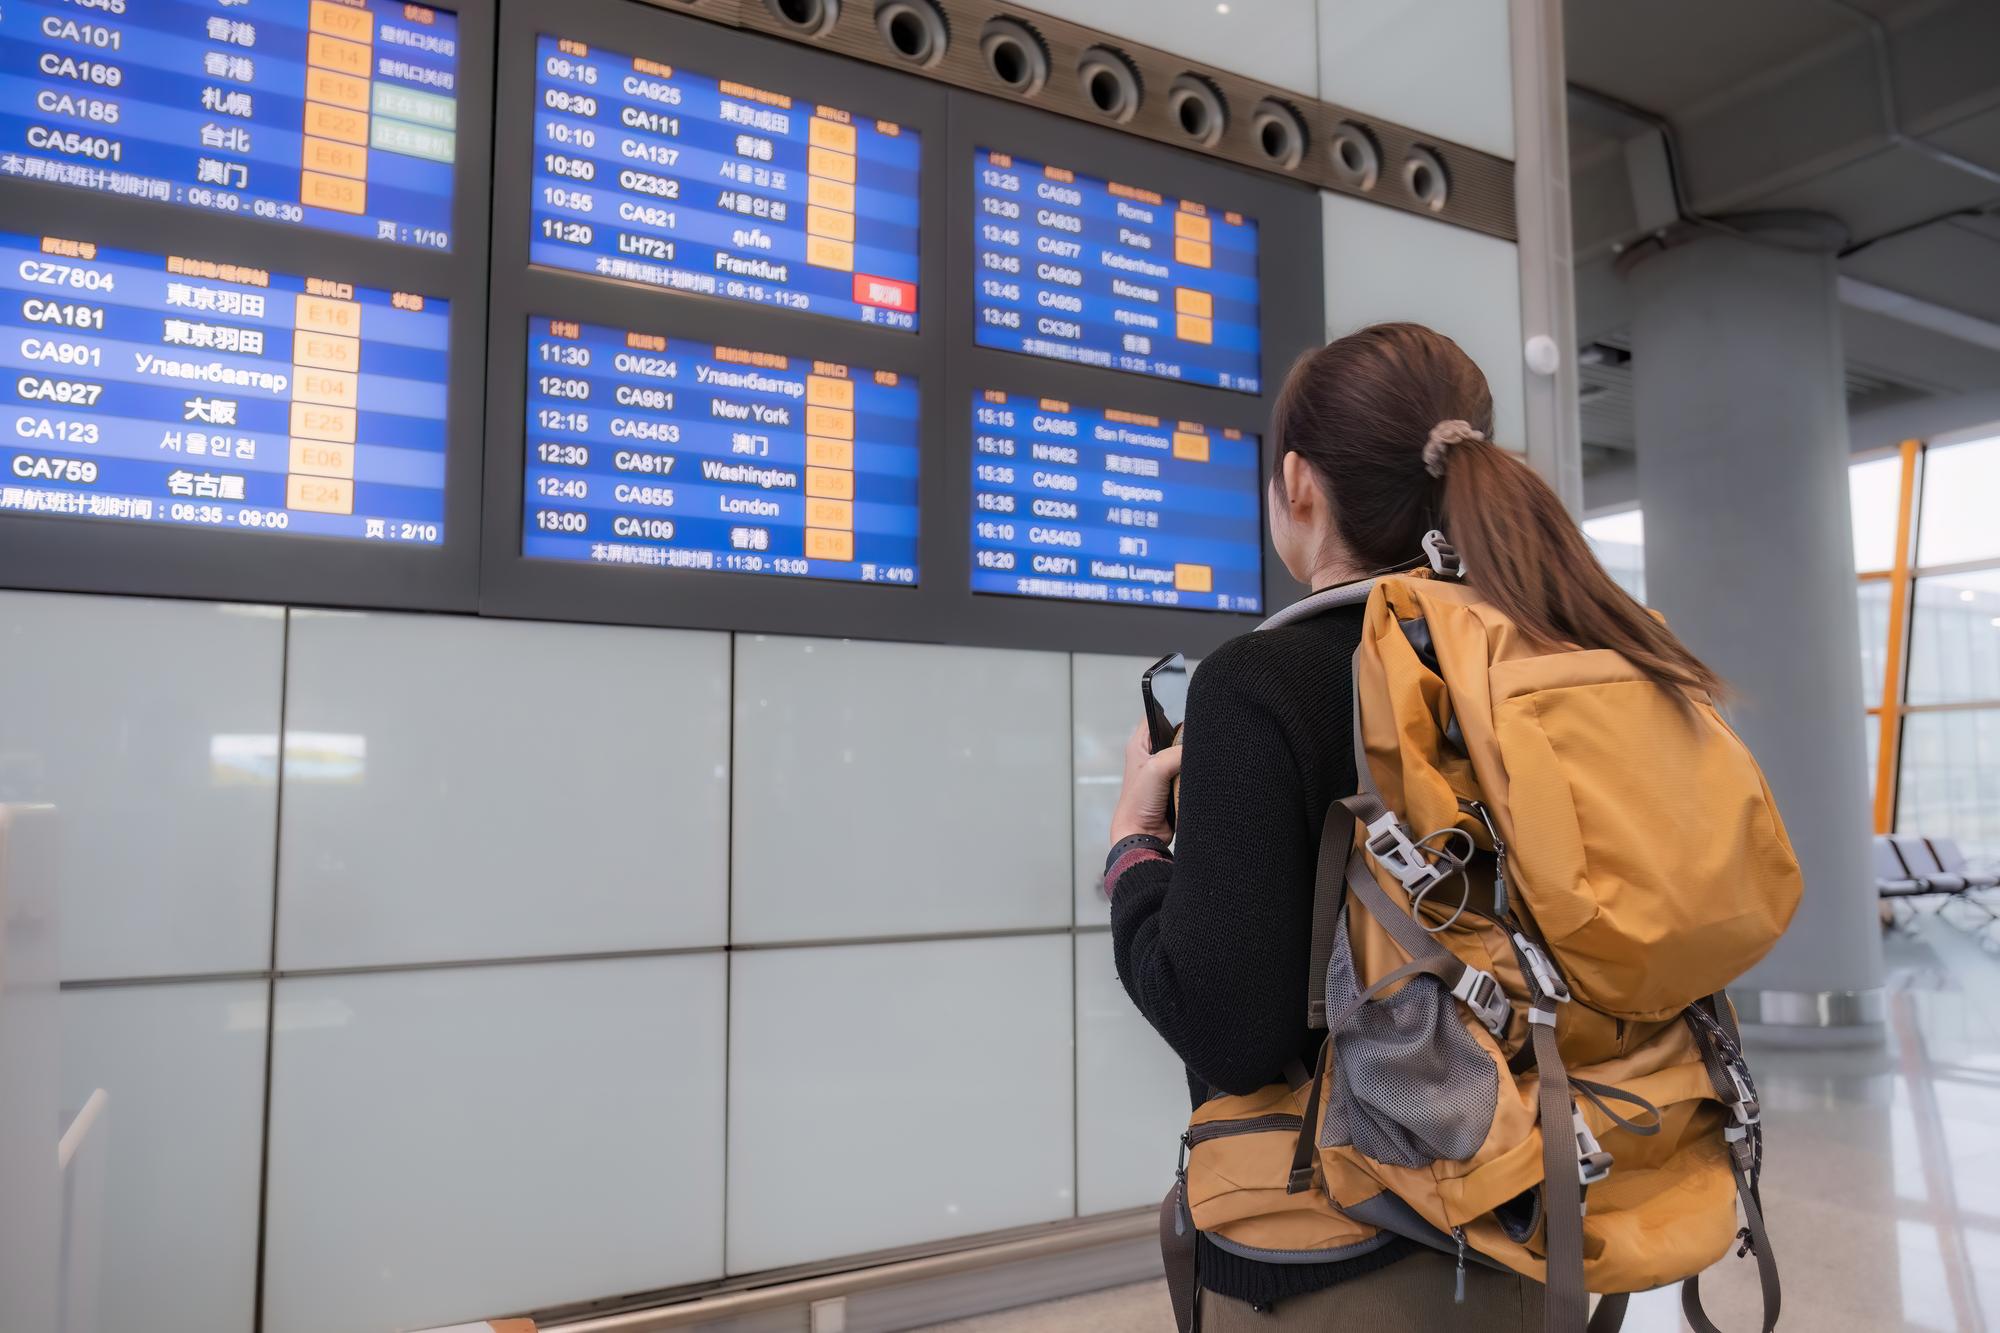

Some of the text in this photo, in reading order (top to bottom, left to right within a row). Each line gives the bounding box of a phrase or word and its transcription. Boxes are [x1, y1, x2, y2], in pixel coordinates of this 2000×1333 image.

[42, 16, 121, 50] CA101
[206, 16, 256, 47] 香港
[322, 9, 361, 30] E07
[40, 53, 122, 87] CA169
[204, 52, 254, 83] 香港
[547, 57, 598, 85] 09:15
[37, 91, 119, 124] CA185
[201, 87, 253, 118] 札幌
[546, 89, 679, 136] 09:30 CA111
[27, 126, 122, 162] CA5401
[201, 122, 250, 153] 台北
[545, 122, 679, 167] 10:10 CA137
[735, 134, 773, 161] 香港
[198, 157, 248, 189] 澳门
[545, 155, 679, 199] 10:50 OZ332
[544, 187, 593, 212] 10:55
[542, 219, 788, 282] 11:20 LH721 Frankfurt
[19, 260, 114, 292] CZ7804
[22, 299, 104, 330] CA181
[166, 282, 265, 318] 東京羽田
[163, 319, 264, 355] 東京羽田
[20, 338, 102, 368] CA901
[540, 343, 678, 378] 11:30 OM224
[135, 352, 288, 393] Улаанбаатар
[17, 376, 102, 405] CA927
[539, 377, 590, 399] 12:00
[712, 398, 750, 420] New
[752, 403, 789, 425] York
[184, 397, 237, 425] 大阪
[538, 410, 680, 443] 12:15 CA5453
[977, 408, 1014, 427] 15:15
[1095, 425, 1118, 442] San
[15, 416, 99, 444] CA123
[977, 436, 1014, 455] 15:15
[12, 455, 97, 483] CA759
[538, 443, 797, 489] 12:30 CA817 Washington
[168, 470, 245, 500] 名古屋
[537, 477, 780, 517] 12:40 CA855 London
[1102, 480, 1163, 502] Singapore
[537, 510, 674, 540] 13:00 CA109
[730, 527, 769, 551] 香港
[1091, 561, 1127, 579] Kuala
[1129, 565, 1174, 584] Lumpur
